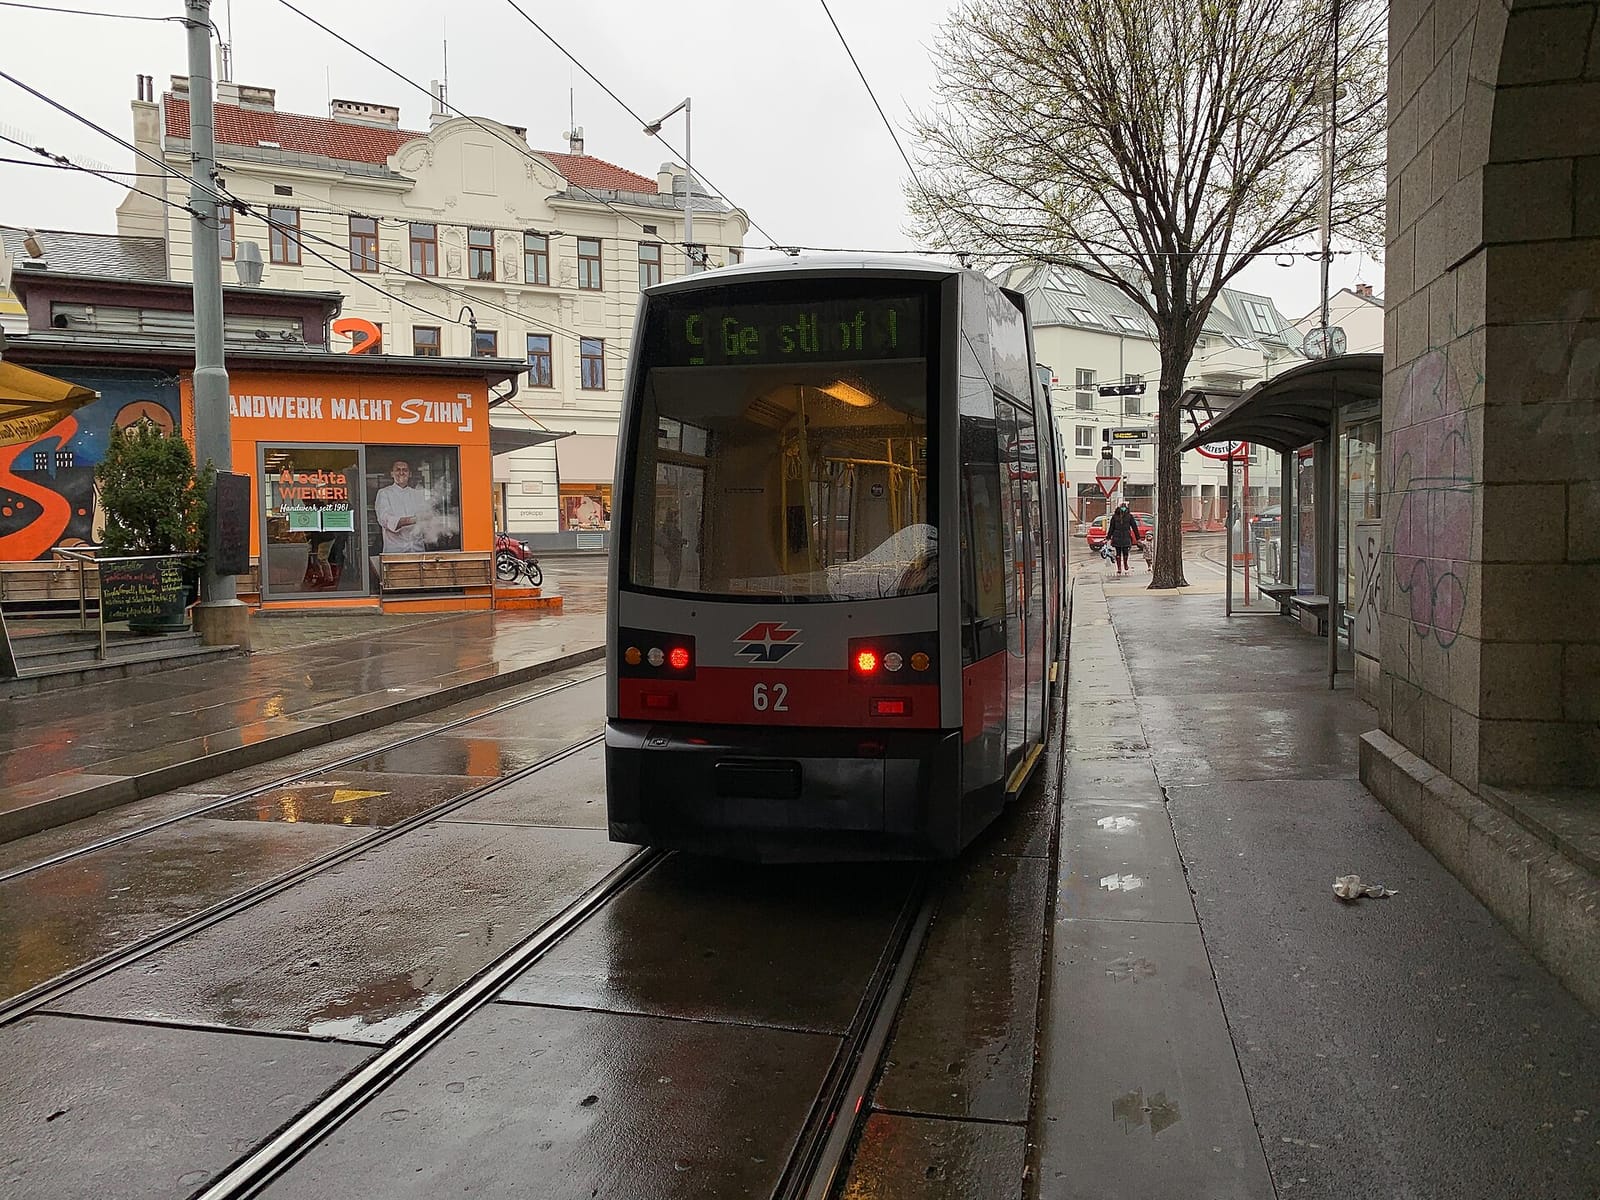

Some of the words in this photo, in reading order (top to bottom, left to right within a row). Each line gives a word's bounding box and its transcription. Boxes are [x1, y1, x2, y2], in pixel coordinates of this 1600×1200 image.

[229, 395, 324, 419] ANDWERK
[331, 399, 392, 421] MACHT
[396, 398, 464, 424] SZIHN
[279, 469, 294, 484] A
[298, 469, 347, 484] echta
[279, 487, 348, 500] WIENER!
[280, 503, 319, 513] Handwerk
[319, 503, 334, 512] seit
[753, 682, 789, 711] 62
